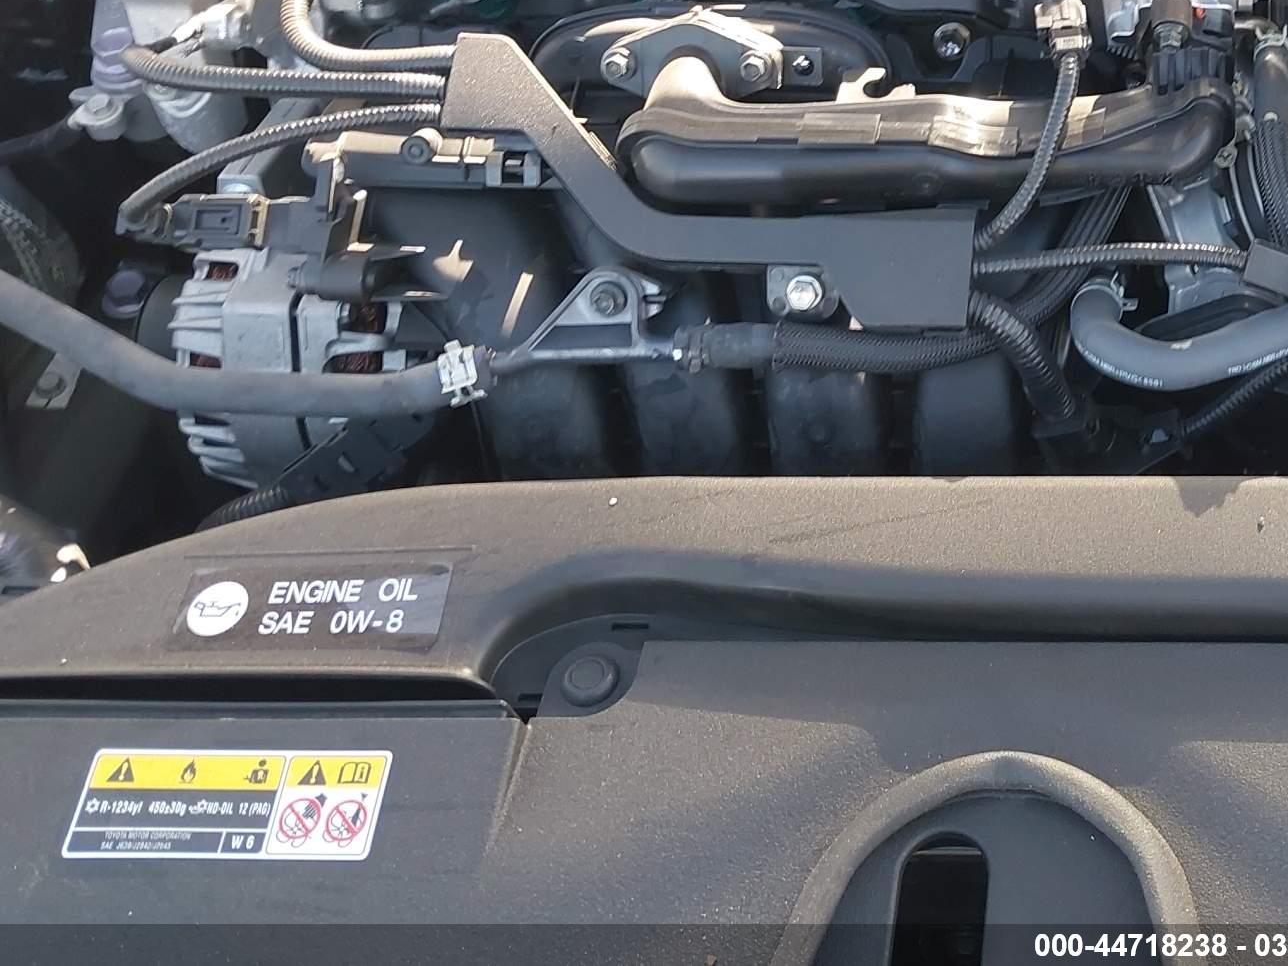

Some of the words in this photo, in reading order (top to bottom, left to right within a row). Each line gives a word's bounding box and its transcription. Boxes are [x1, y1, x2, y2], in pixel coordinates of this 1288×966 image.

[268, 579, 364, 604] ENGINE
[378, 578, 418, 602] OIL
[258, 611, 314, 635] SAE
[330, 610, 404, 634] 0W-8
[246, 836, 256, 849] 6
